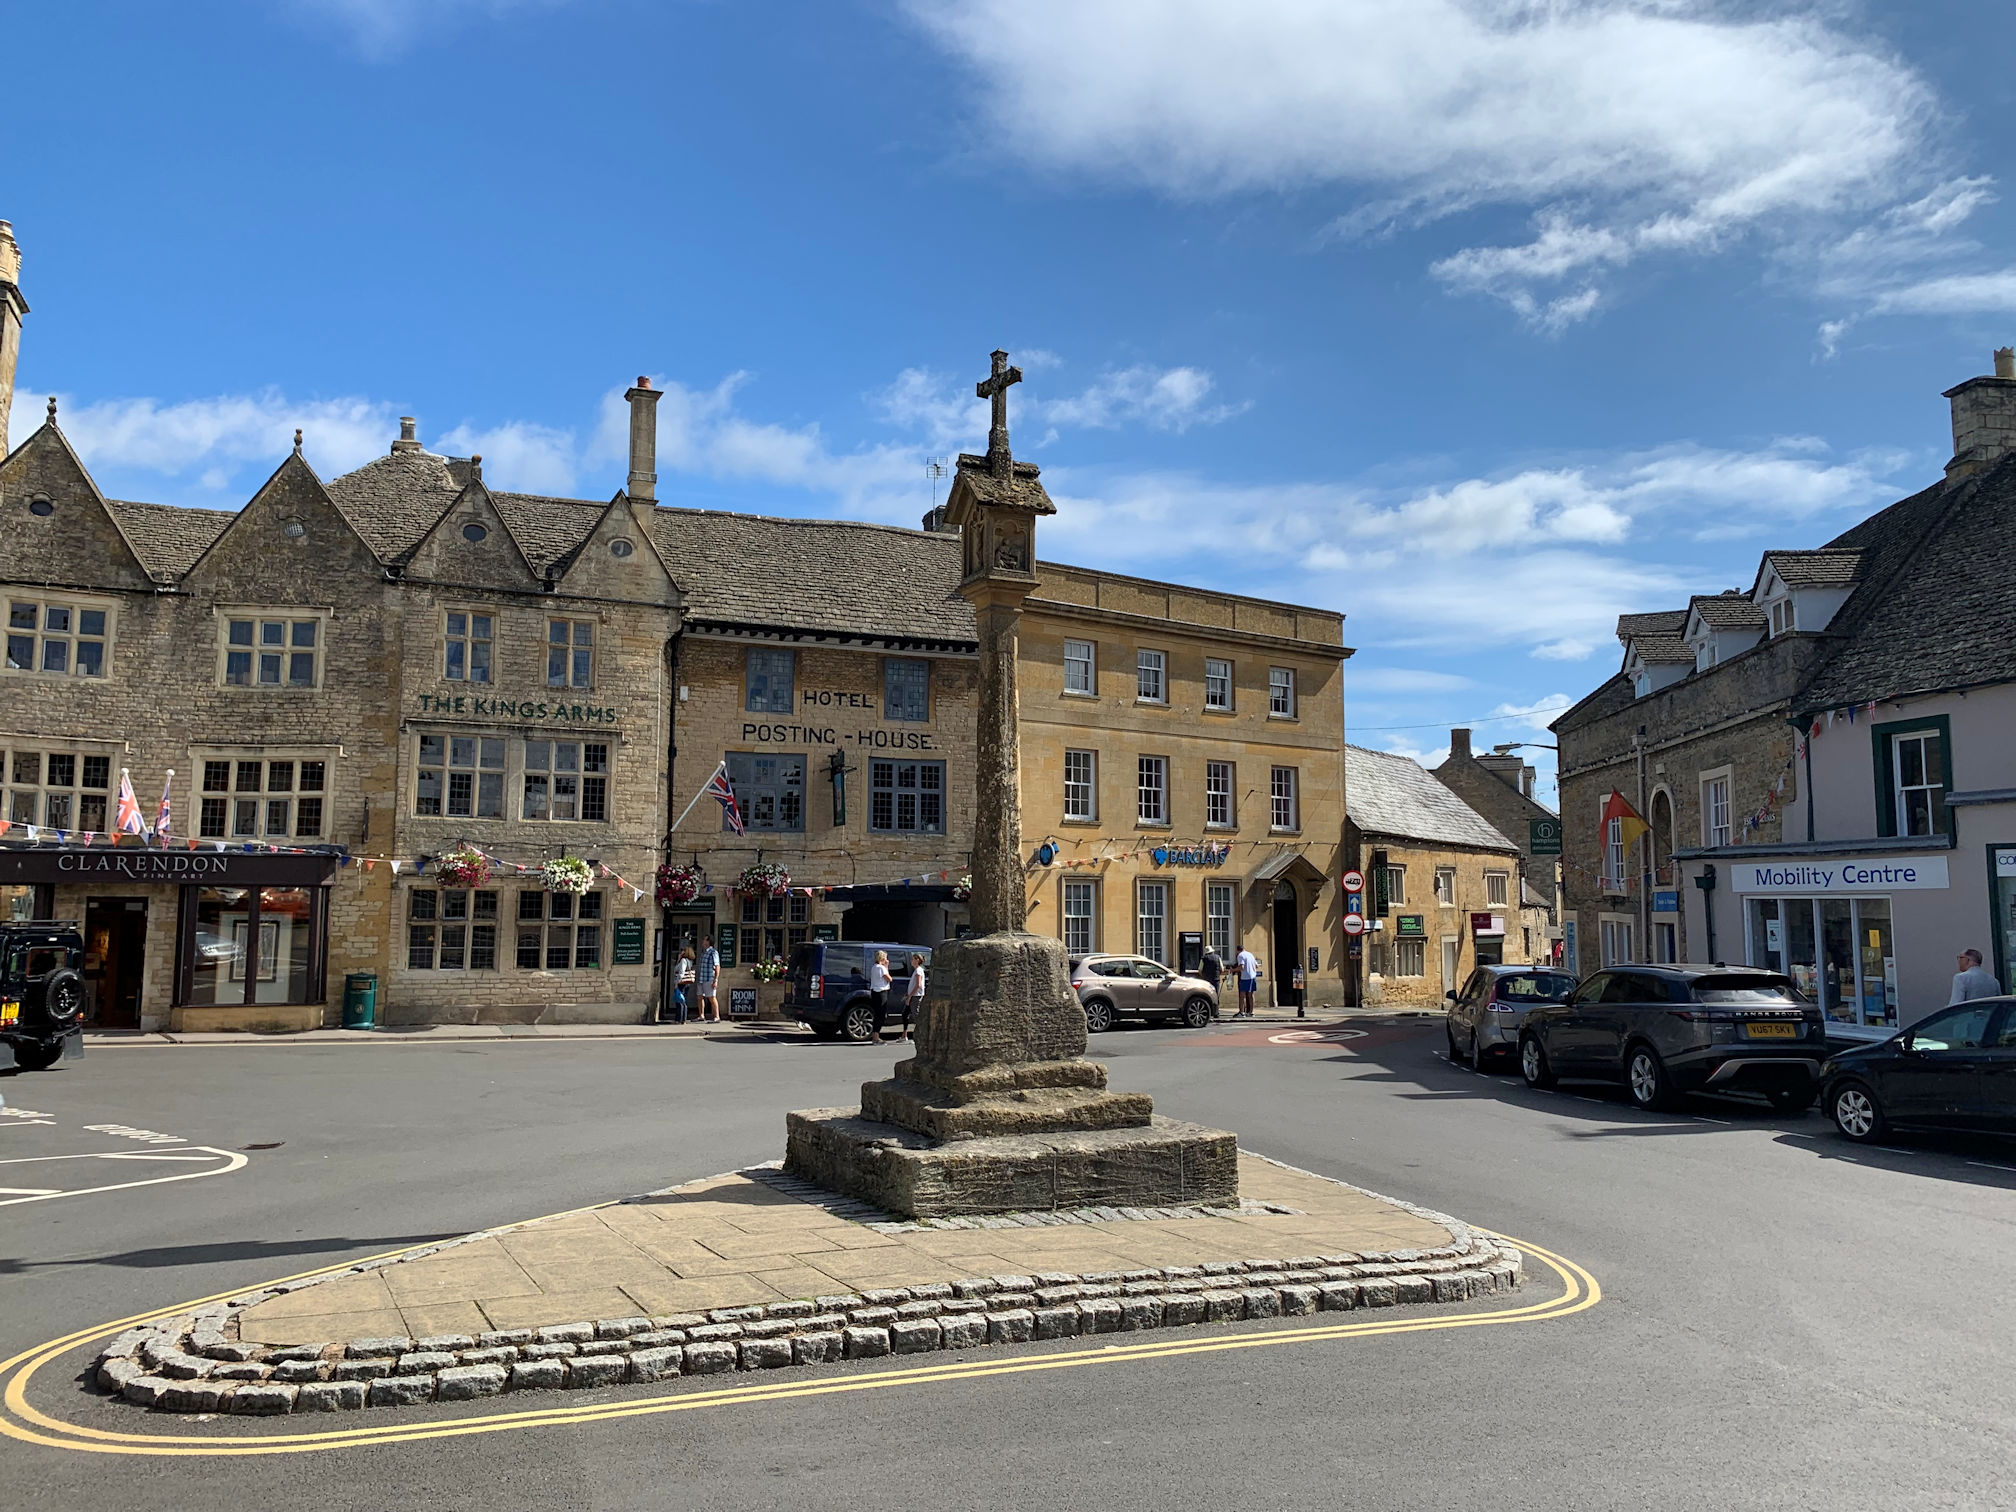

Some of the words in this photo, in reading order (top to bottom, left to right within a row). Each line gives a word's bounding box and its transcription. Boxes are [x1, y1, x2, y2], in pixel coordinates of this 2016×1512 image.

[419, 694, 465, 713] THE
[474, 699, 548, 718] KINGS
[554, 704, 616, 723] ARMS
[803, 690, 874, 708] HOTEL
[742, 723, 836, 744] POSTING
[58, 855, 228, 878] CLARENDON
[1998, 856, 2016, 865] CO
[1755, 868, 1834, 887] Mobility
[1841, 865, 1917, 883] Centre
[732, 990, 755, 999] ROOM
[1751, 1025, 1773, 1033] VU67
